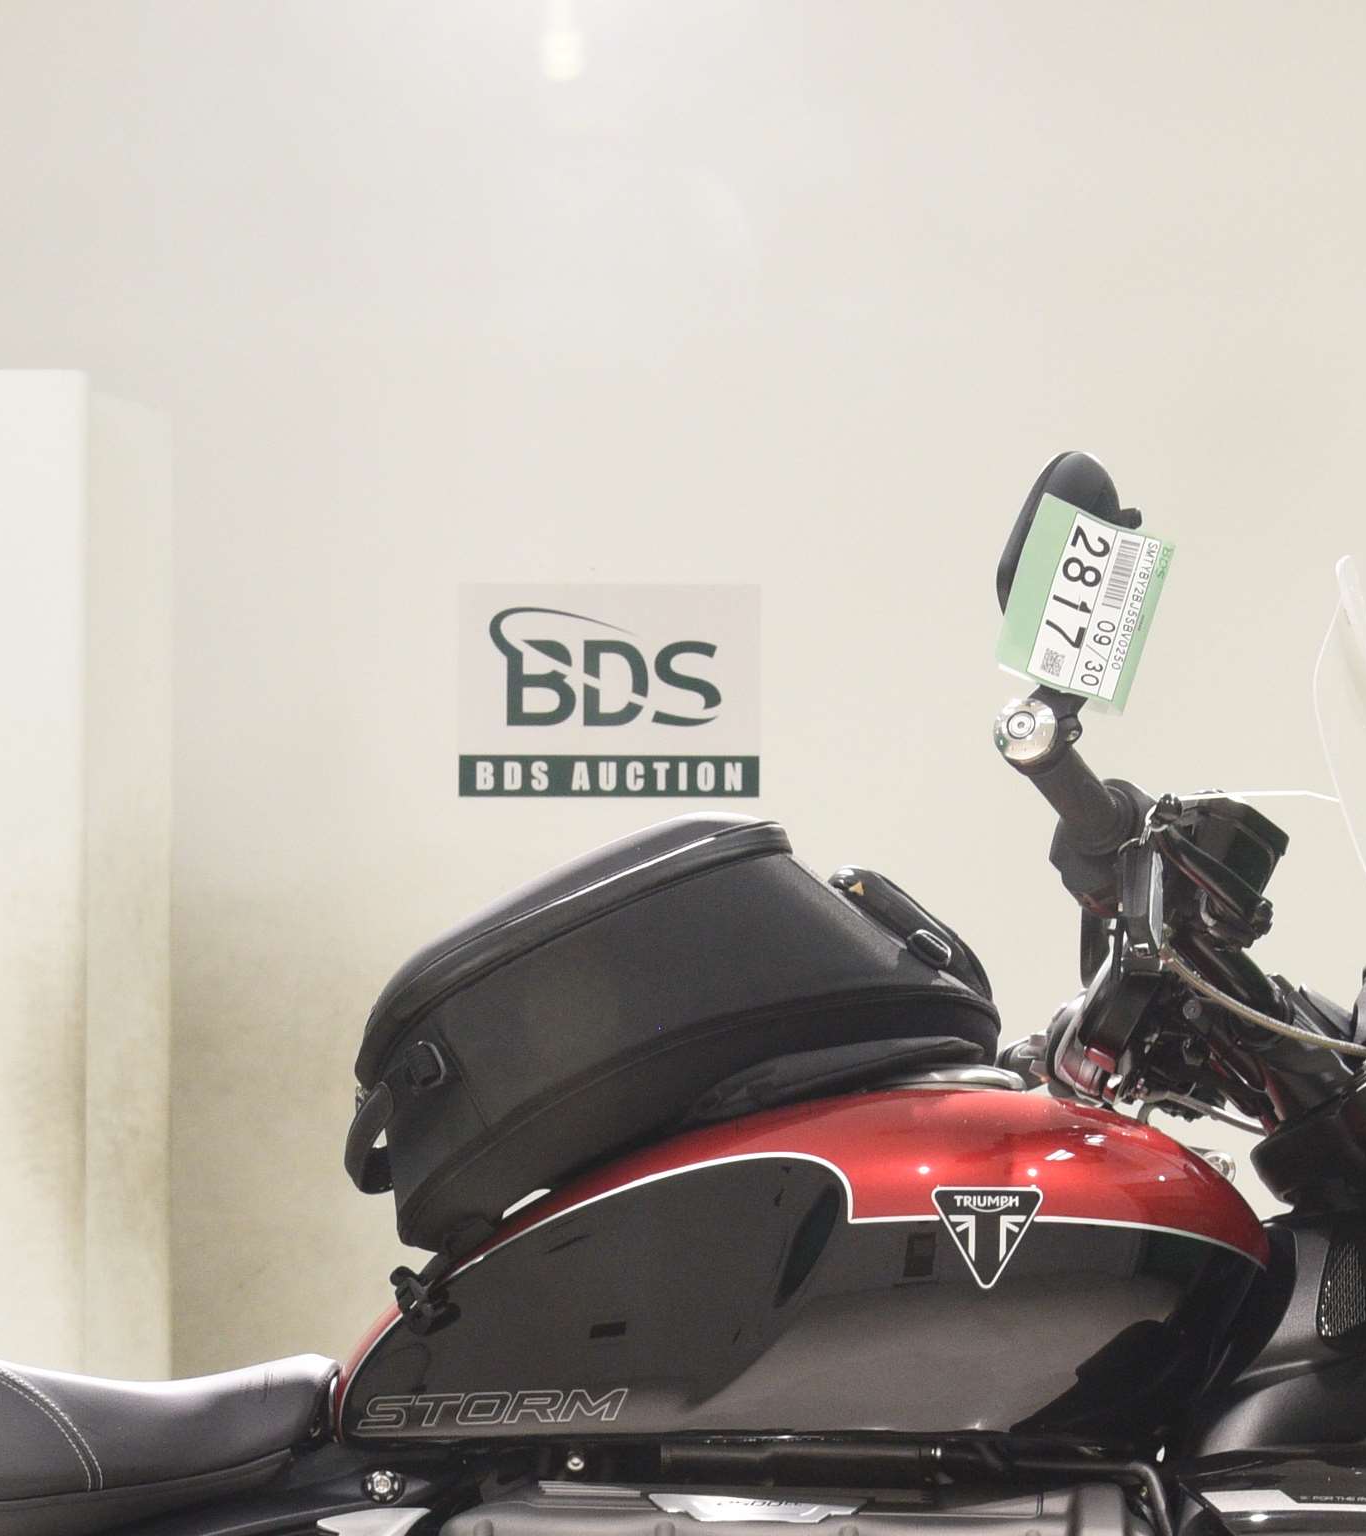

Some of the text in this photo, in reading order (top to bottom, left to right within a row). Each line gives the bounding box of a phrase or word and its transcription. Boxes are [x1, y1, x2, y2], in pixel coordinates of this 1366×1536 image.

[1045, 525, 1111, 649] 2817
[489, 606, 723, 727] BDS
[1080, 618, 1116, 687] 09/30
[475, 760, 744, 792] BDS AUCTION
[953, 1194, 1020, 1212] TRIUMPH
[357, 1388, 629, 1430] STORM
